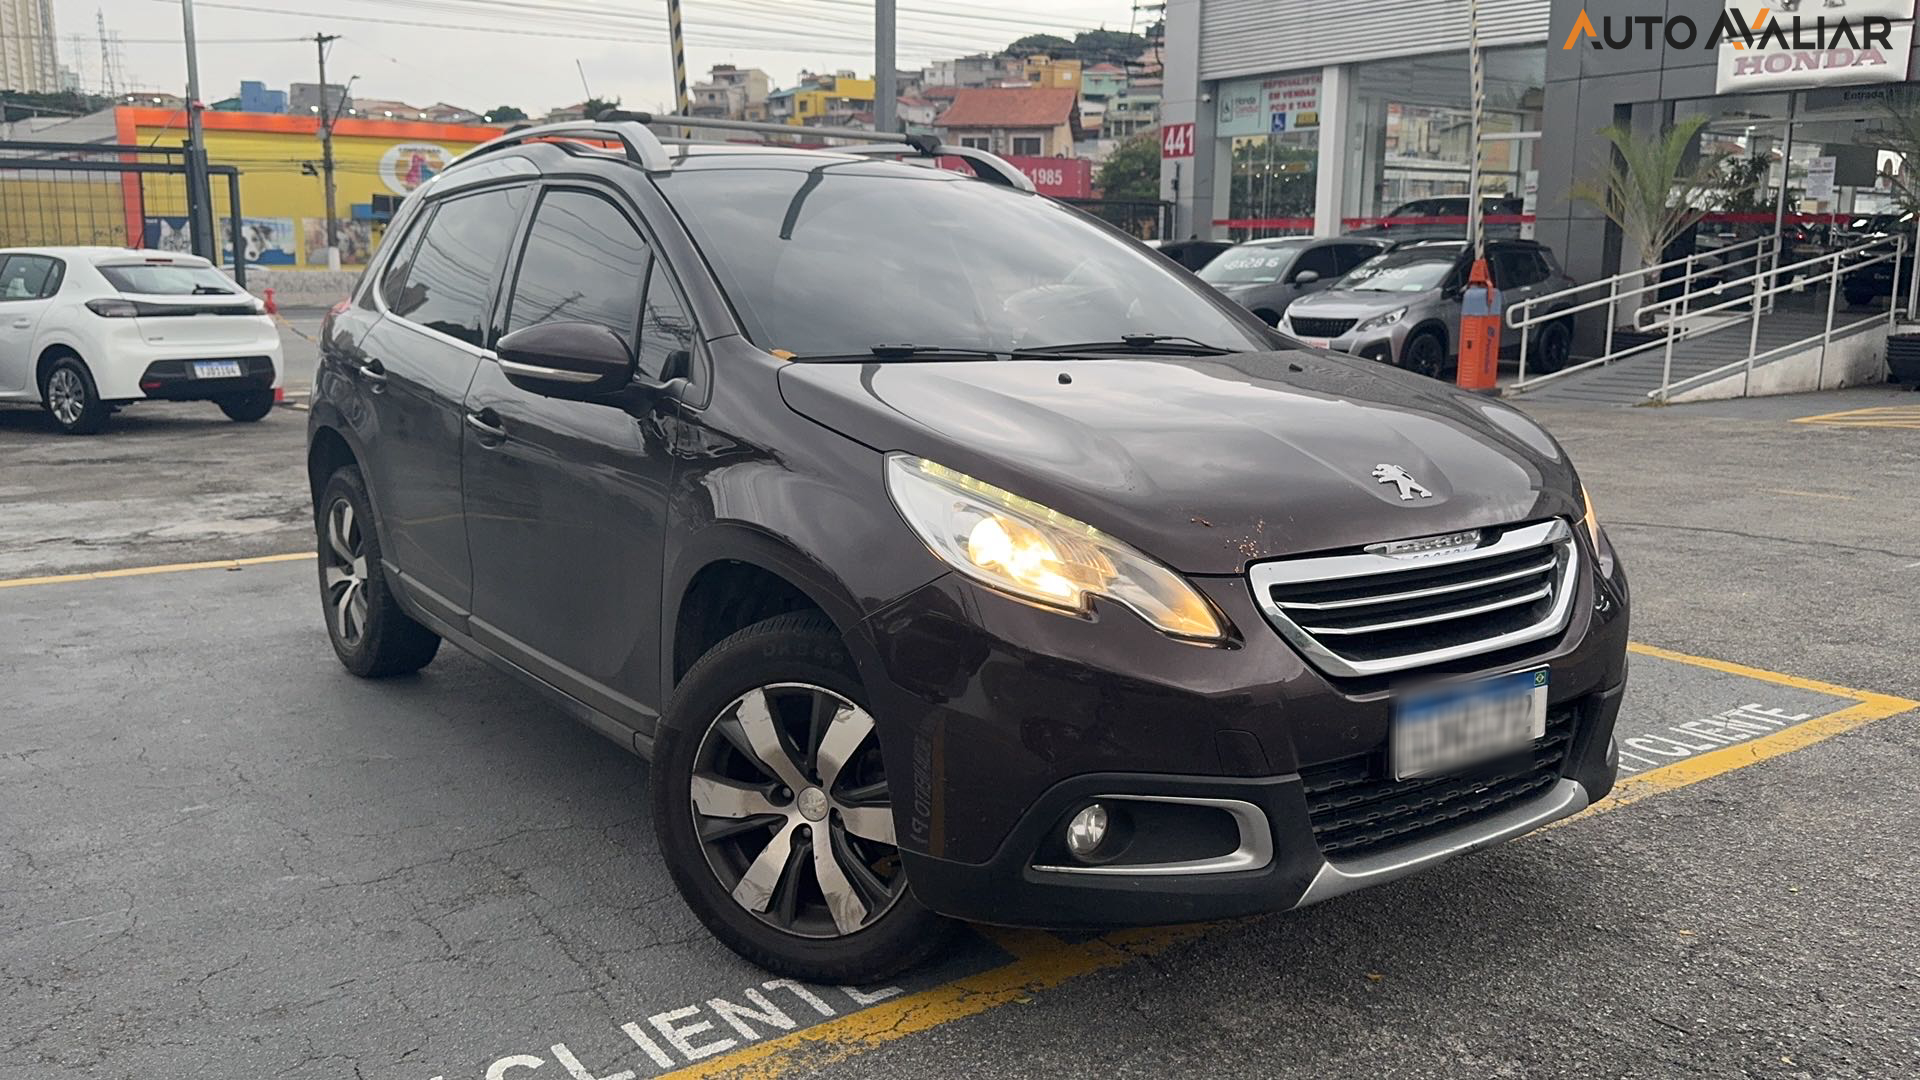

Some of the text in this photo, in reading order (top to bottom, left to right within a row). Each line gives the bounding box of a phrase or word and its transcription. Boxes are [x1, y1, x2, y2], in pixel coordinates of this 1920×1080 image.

[1734, 47, 1887, 76] HONDA
[1283, 88, 1316, 99] VENDAS
[1297, 101, 1316, 110] TAXI
[1165, 125, 1194, 155] 441
[1031, 169, 1062, 186] 1985
[1624, 703, 1811, 756] CLIENTE
